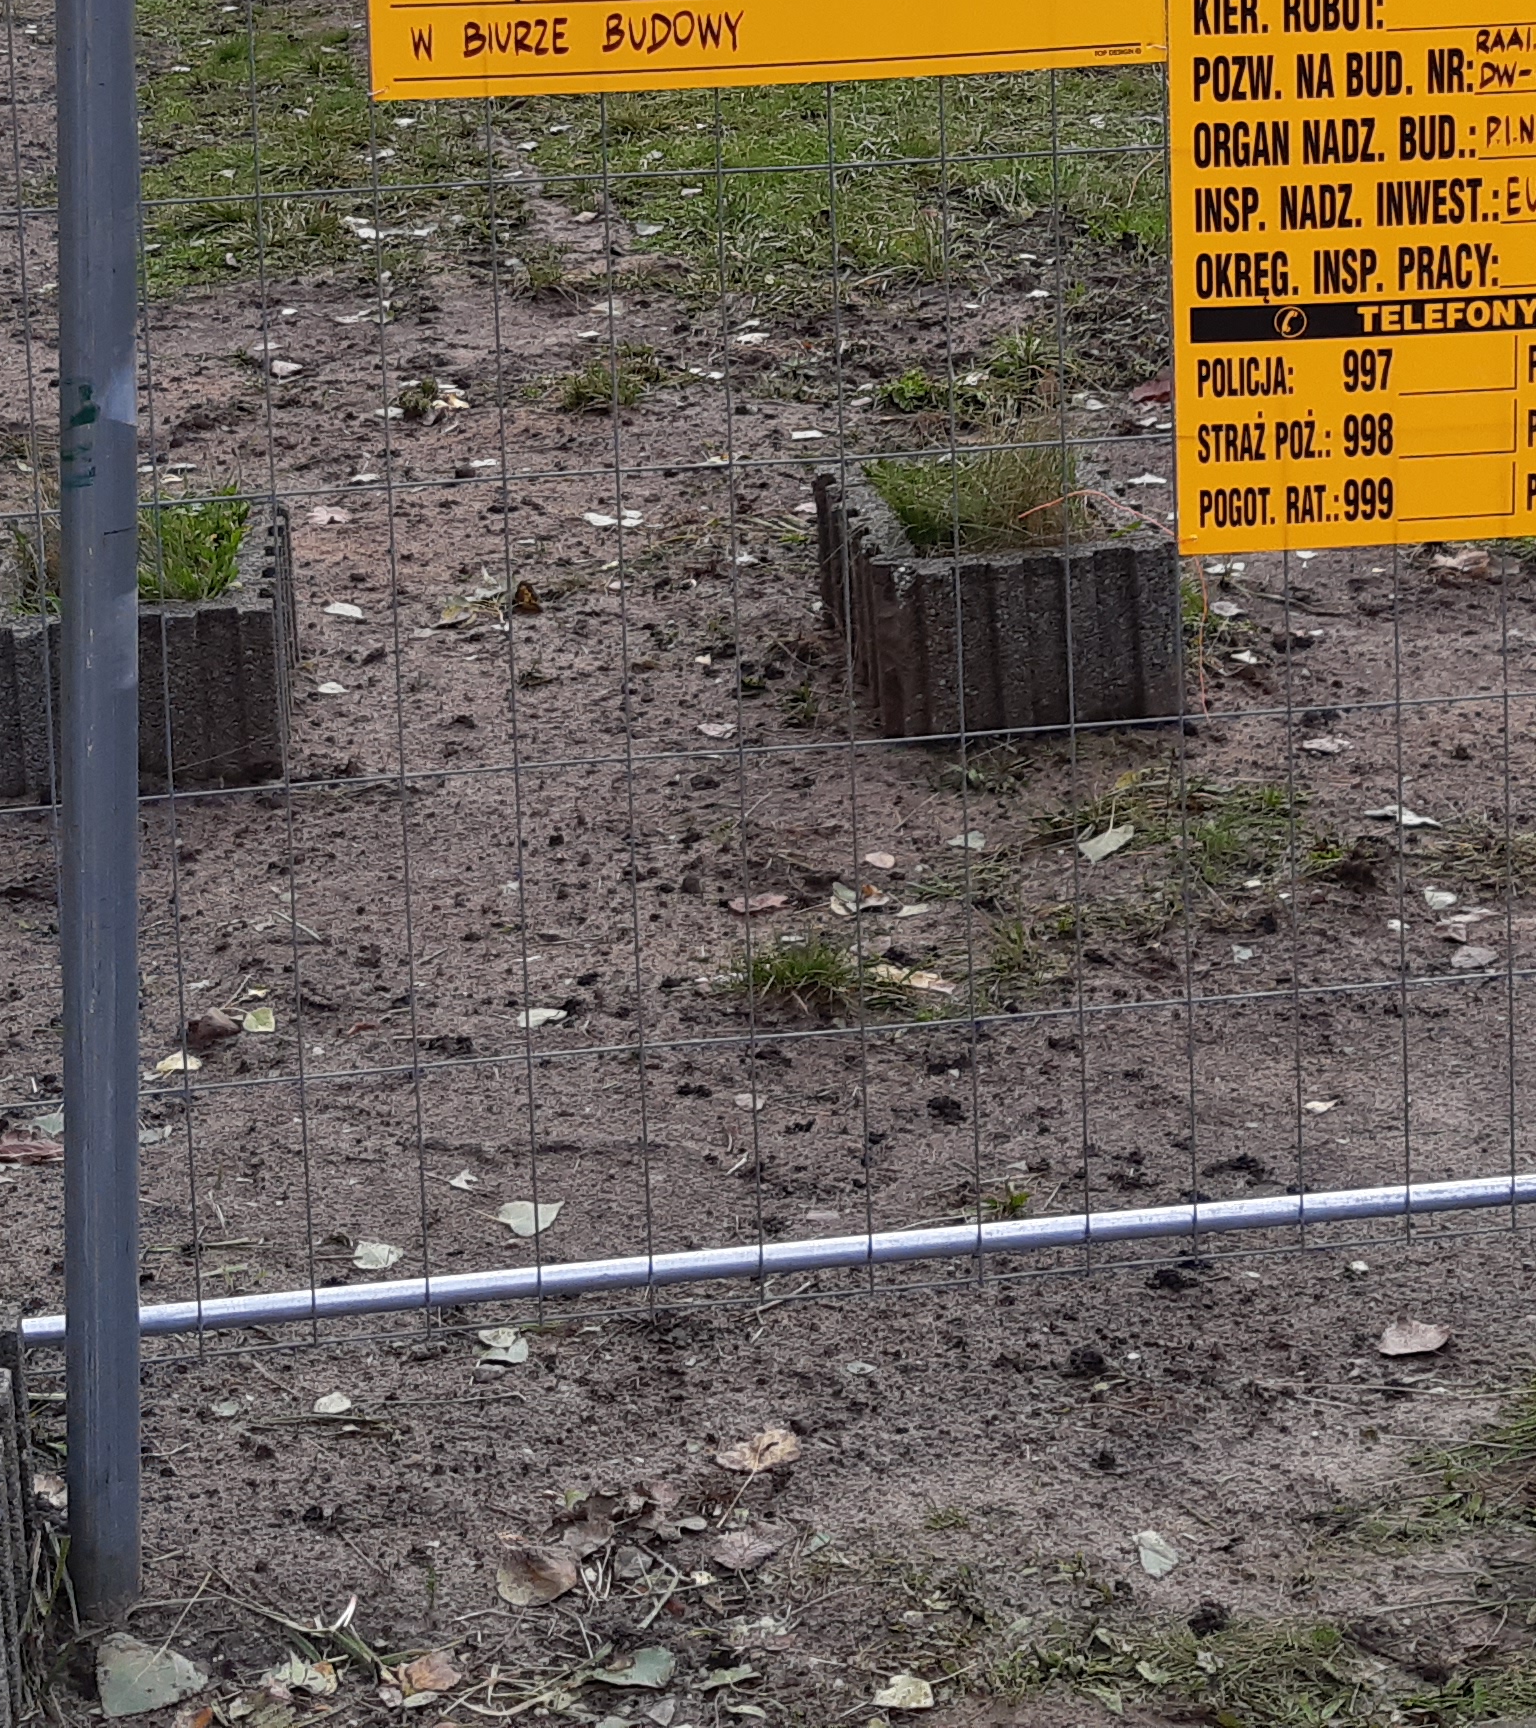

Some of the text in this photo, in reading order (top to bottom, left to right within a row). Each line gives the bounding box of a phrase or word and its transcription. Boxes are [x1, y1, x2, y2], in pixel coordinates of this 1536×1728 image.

[412, 10, 742, 61] W BIURZE BUDOWY
[1193, 53, 1282, 103] POZW.
[1296, 56, 1335, 100] NA
[1345, 52, 1413, 98] BUD.
[1428, 48, 1474, 95] NR:
[1194, 118, 1290, 168] ORGAN
[1302, 117, 1386, 166] NADZ.
[1400, 114, 1477, 163] BUD.:
[1195, 185, 1266, 233] INSP.
[1280, 182, 1363, 231] NADZ.
[1376, 180, 1500, 227] INWEST.:
[1195, 241, 1498, 303] OKRĘG. INSP. PRACY:
[1197, 348, 1393, 398] POLICJA: 997
[1198, 409, 1393, 463] STRAŻ POŻ.: 998
[1199, 478, 1394, 528] POGOT. RAT.: 999
